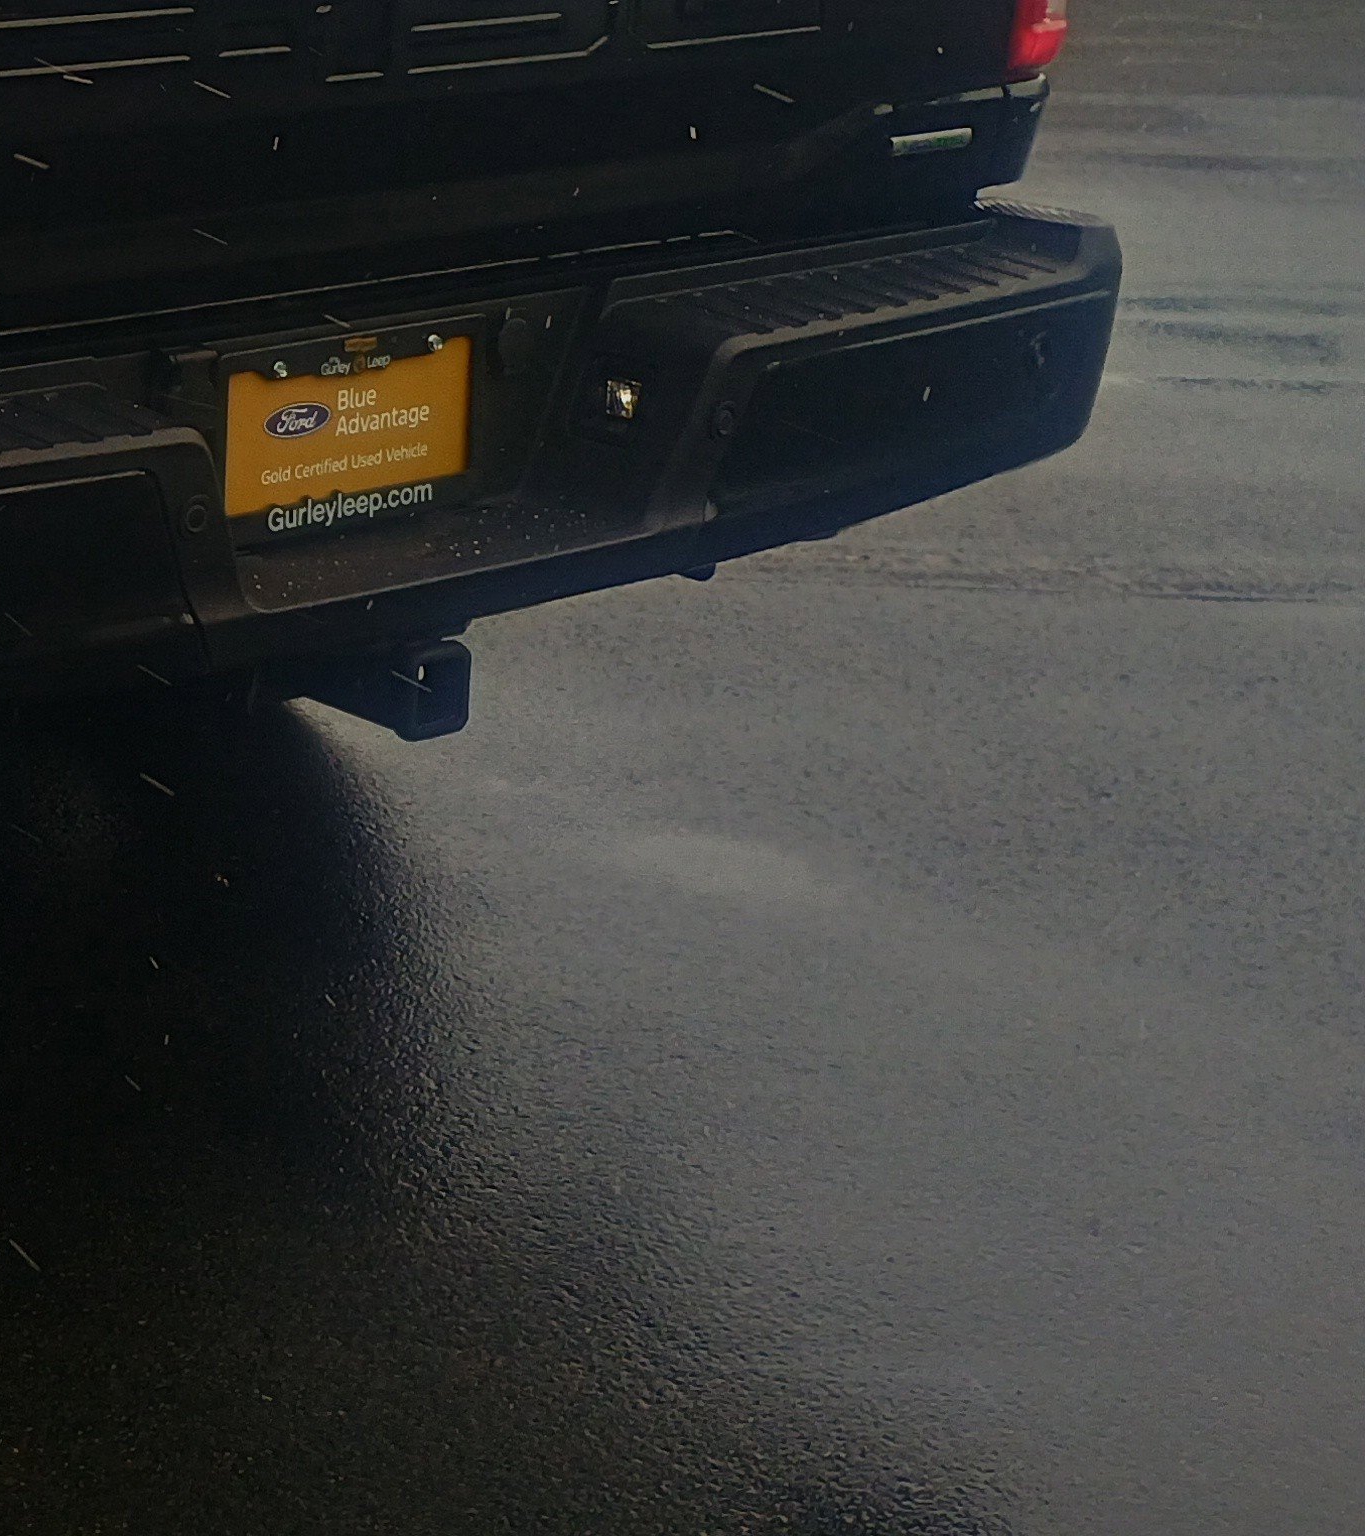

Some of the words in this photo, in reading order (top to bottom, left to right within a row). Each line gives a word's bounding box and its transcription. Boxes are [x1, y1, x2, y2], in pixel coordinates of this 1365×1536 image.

[276, 407, 318, 433] Ford
[337, 387, 377, 411] Blue
[335, 405, 430, 436] Advantage
[261, 465, 291, 485] Gold
[295, 455, 348, 479] Certified
[351, 450, 383, 469] Used
[386, 442, 428, 462] Vehicle
[267, 482, 433, 532] Gurleyleep.com
